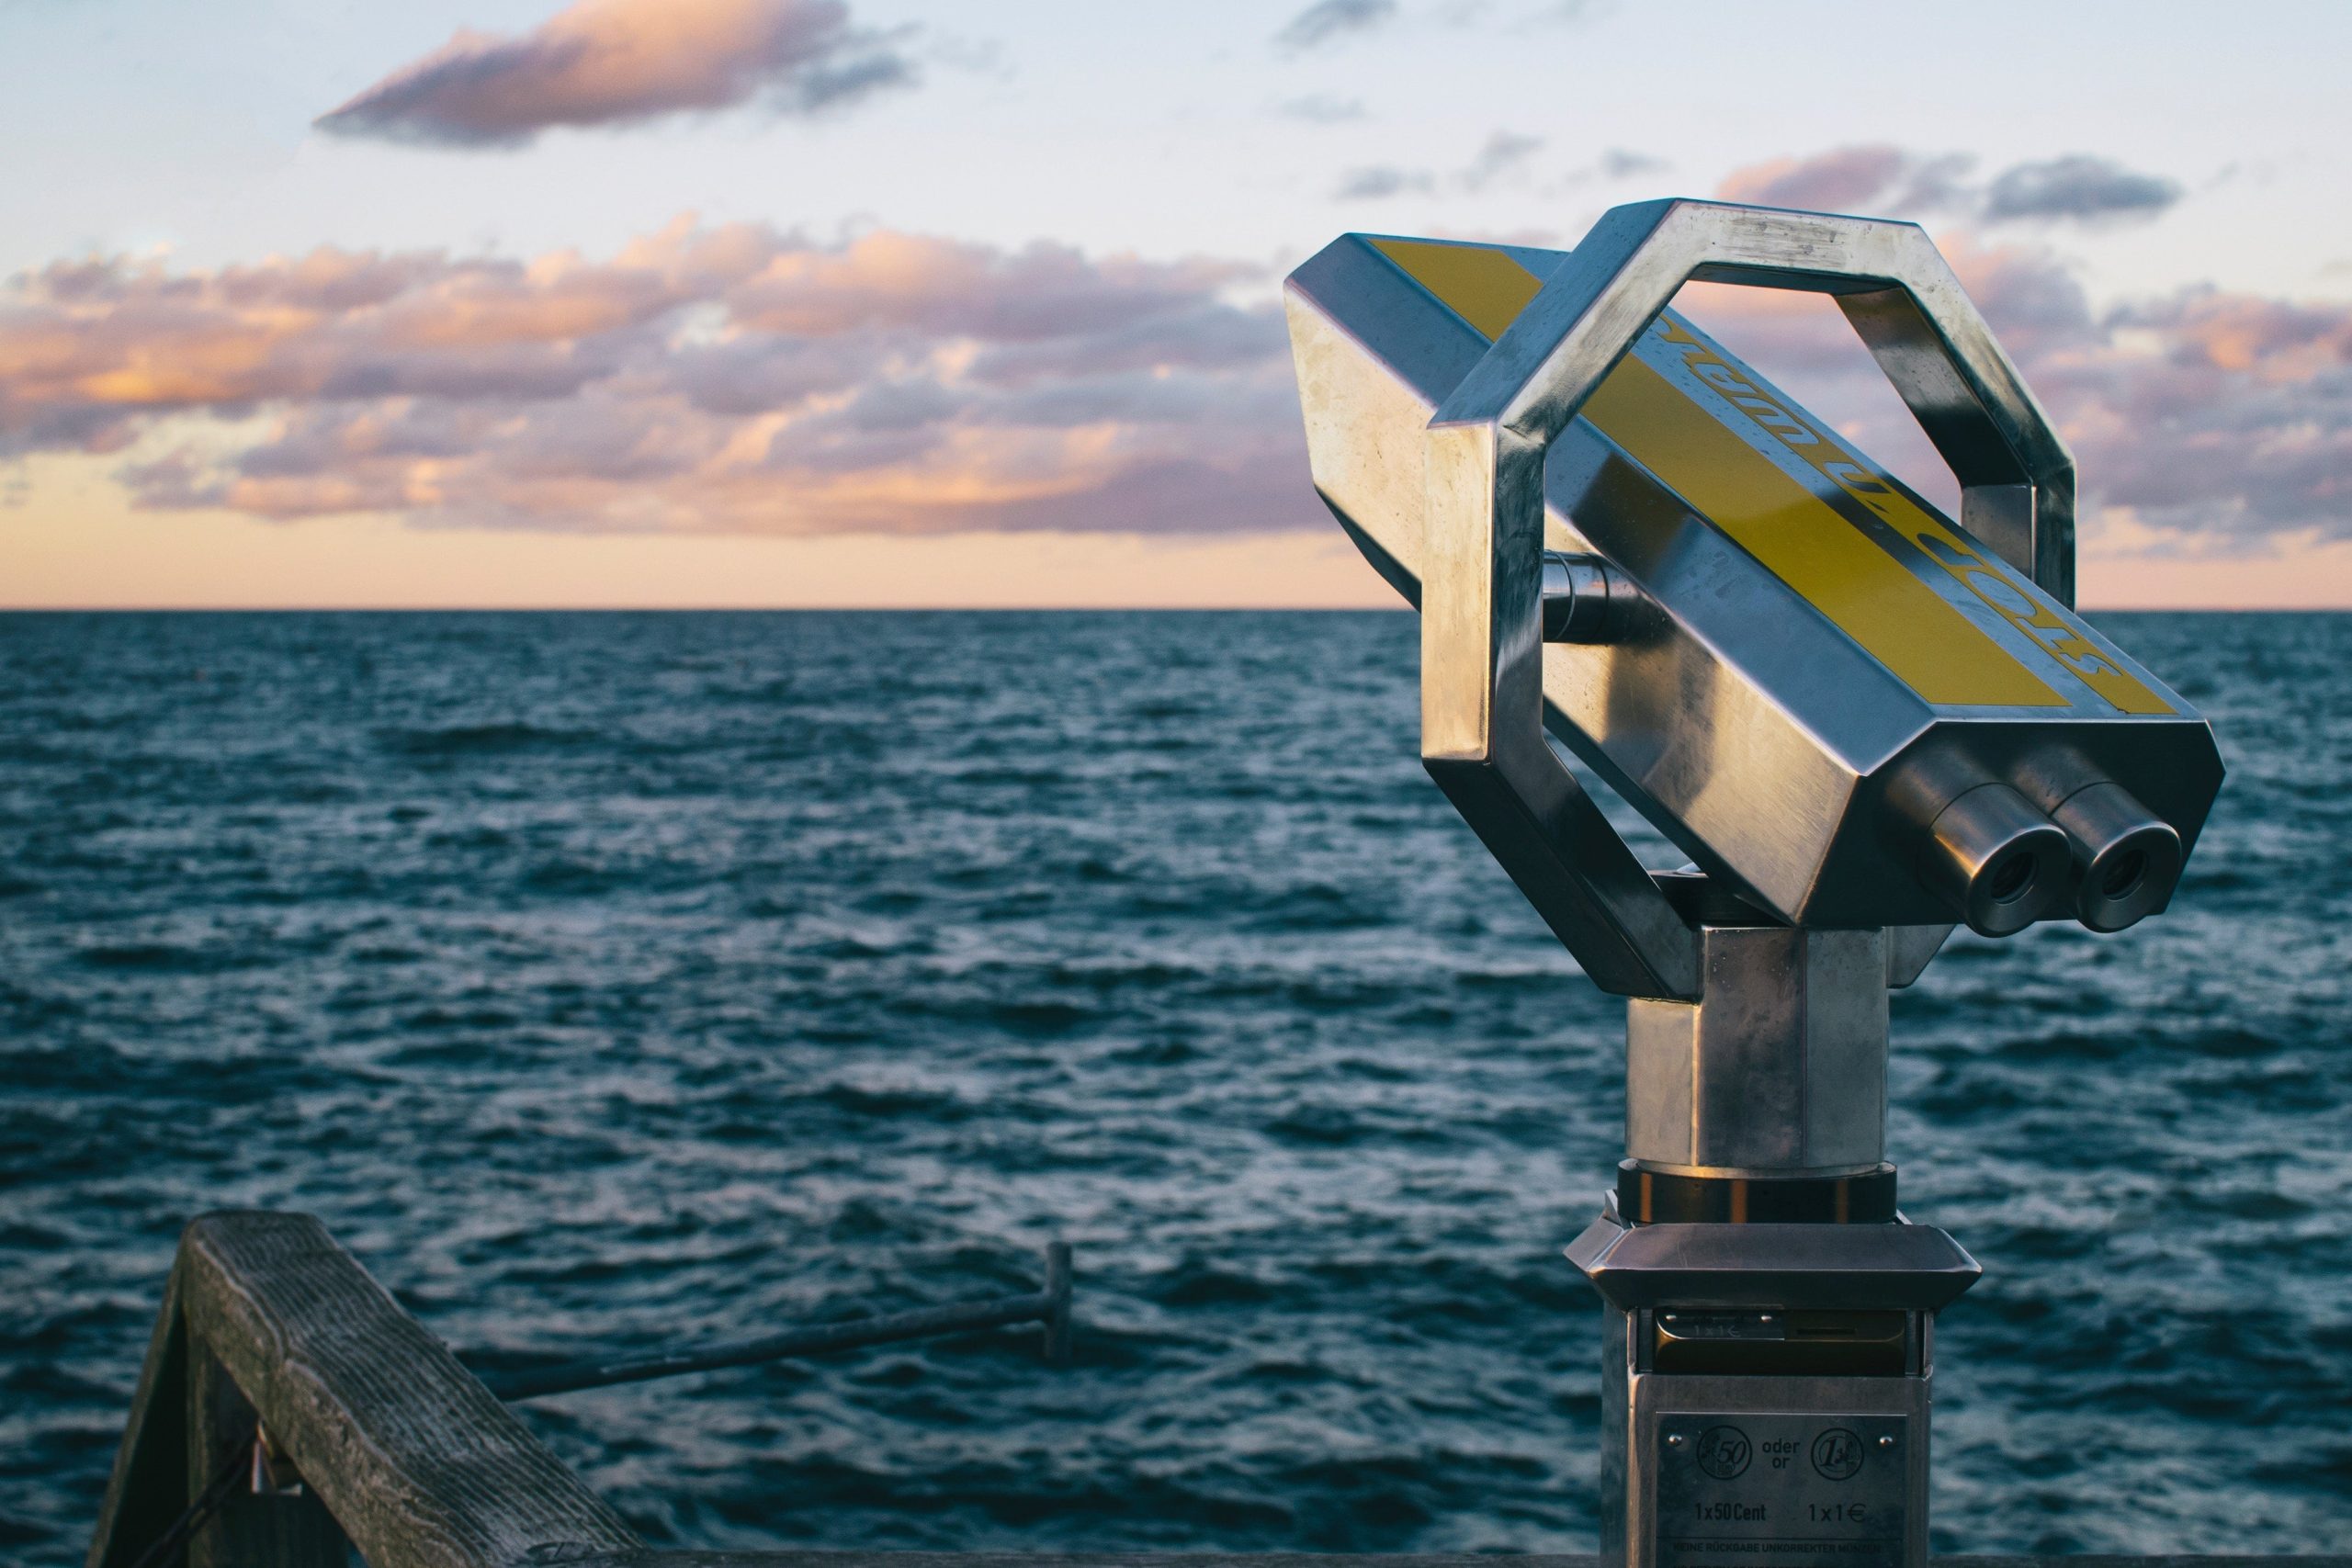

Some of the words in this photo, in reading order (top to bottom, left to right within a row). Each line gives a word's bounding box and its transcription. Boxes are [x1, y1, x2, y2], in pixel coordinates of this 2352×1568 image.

[1917, 533, 2123, 676] STOP
[1717, 1440, 1747, 1464] 50
[1761, 1438, 1800, 1453] oder
[1819, 1438, 1838, 1467] 1
[1771, 1457, 1791, 1470] or
[1673, 1542, 1703, 1552] KEINE
[1706, 1541, 1758, 1552] RÜCKGABE
[1762, 1542, 1835, 1553] UNKORREKTER
